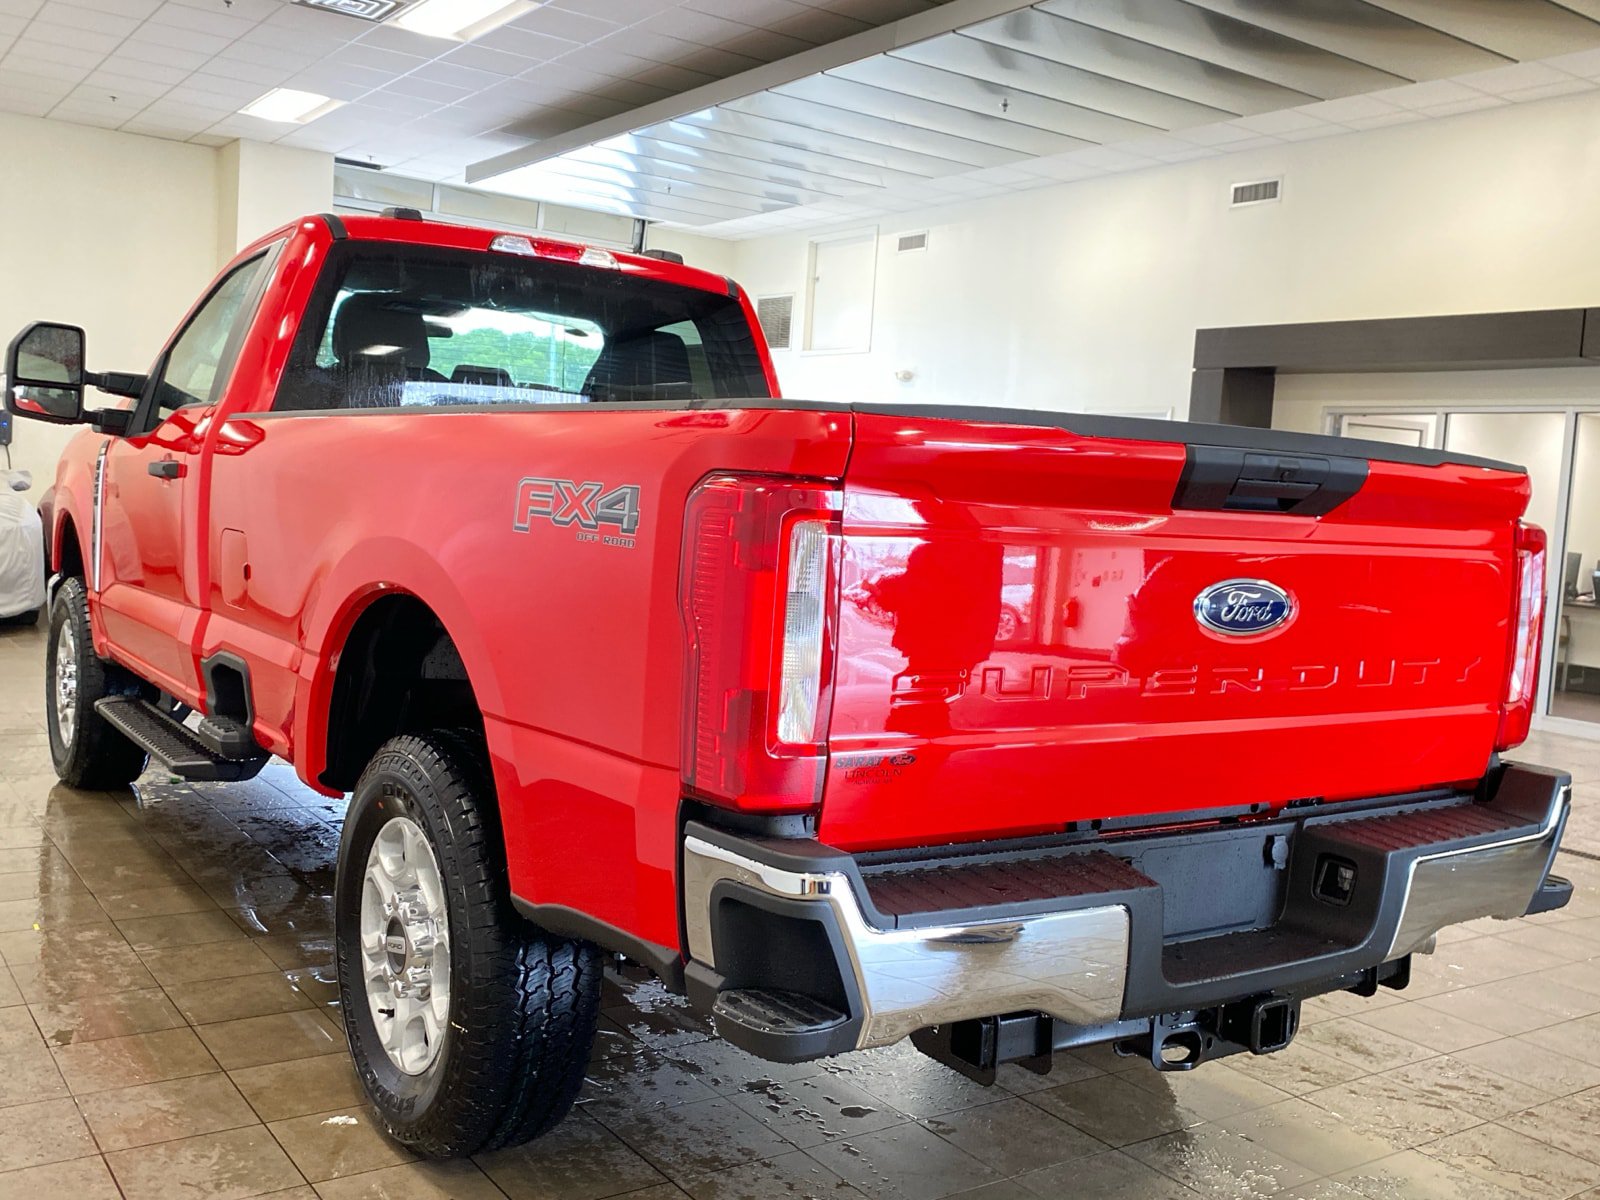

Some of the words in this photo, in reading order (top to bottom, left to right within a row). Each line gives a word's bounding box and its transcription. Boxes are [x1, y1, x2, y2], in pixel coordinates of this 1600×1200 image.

[513, 477, 641, 536] FX4
[576, 532, 600, 542] OFF
[603, 536, 635, 548] ROAD
[1221, 590, 1274, 622] Ford
[890, 664, 1264, 705] SUPER
[1289, 656, 1481, 691] DUTY
